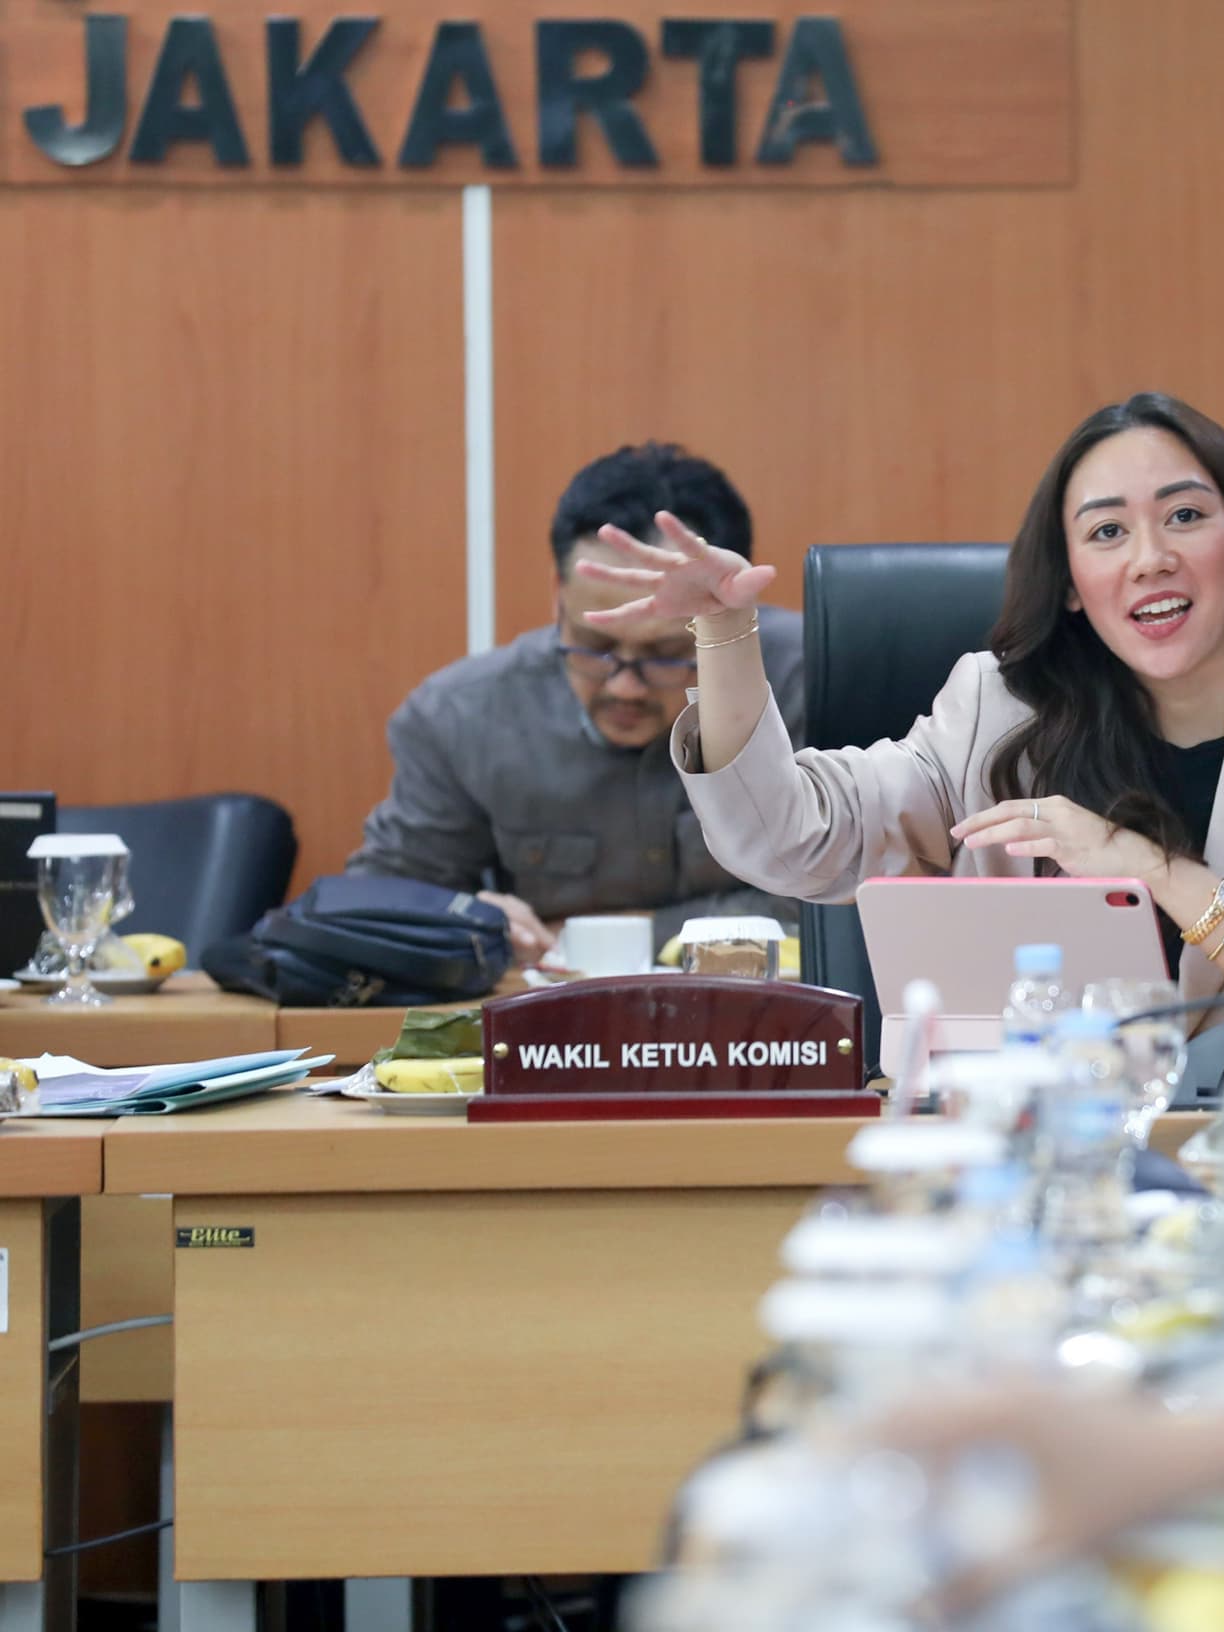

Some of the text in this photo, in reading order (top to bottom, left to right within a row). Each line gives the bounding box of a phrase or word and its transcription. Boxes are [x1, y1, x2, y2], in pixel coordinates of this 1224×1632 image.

[23, 13, 879, 168] JAKARTA
[519, 1041, 827, 1069] WAKIL KETUA KOMISI
